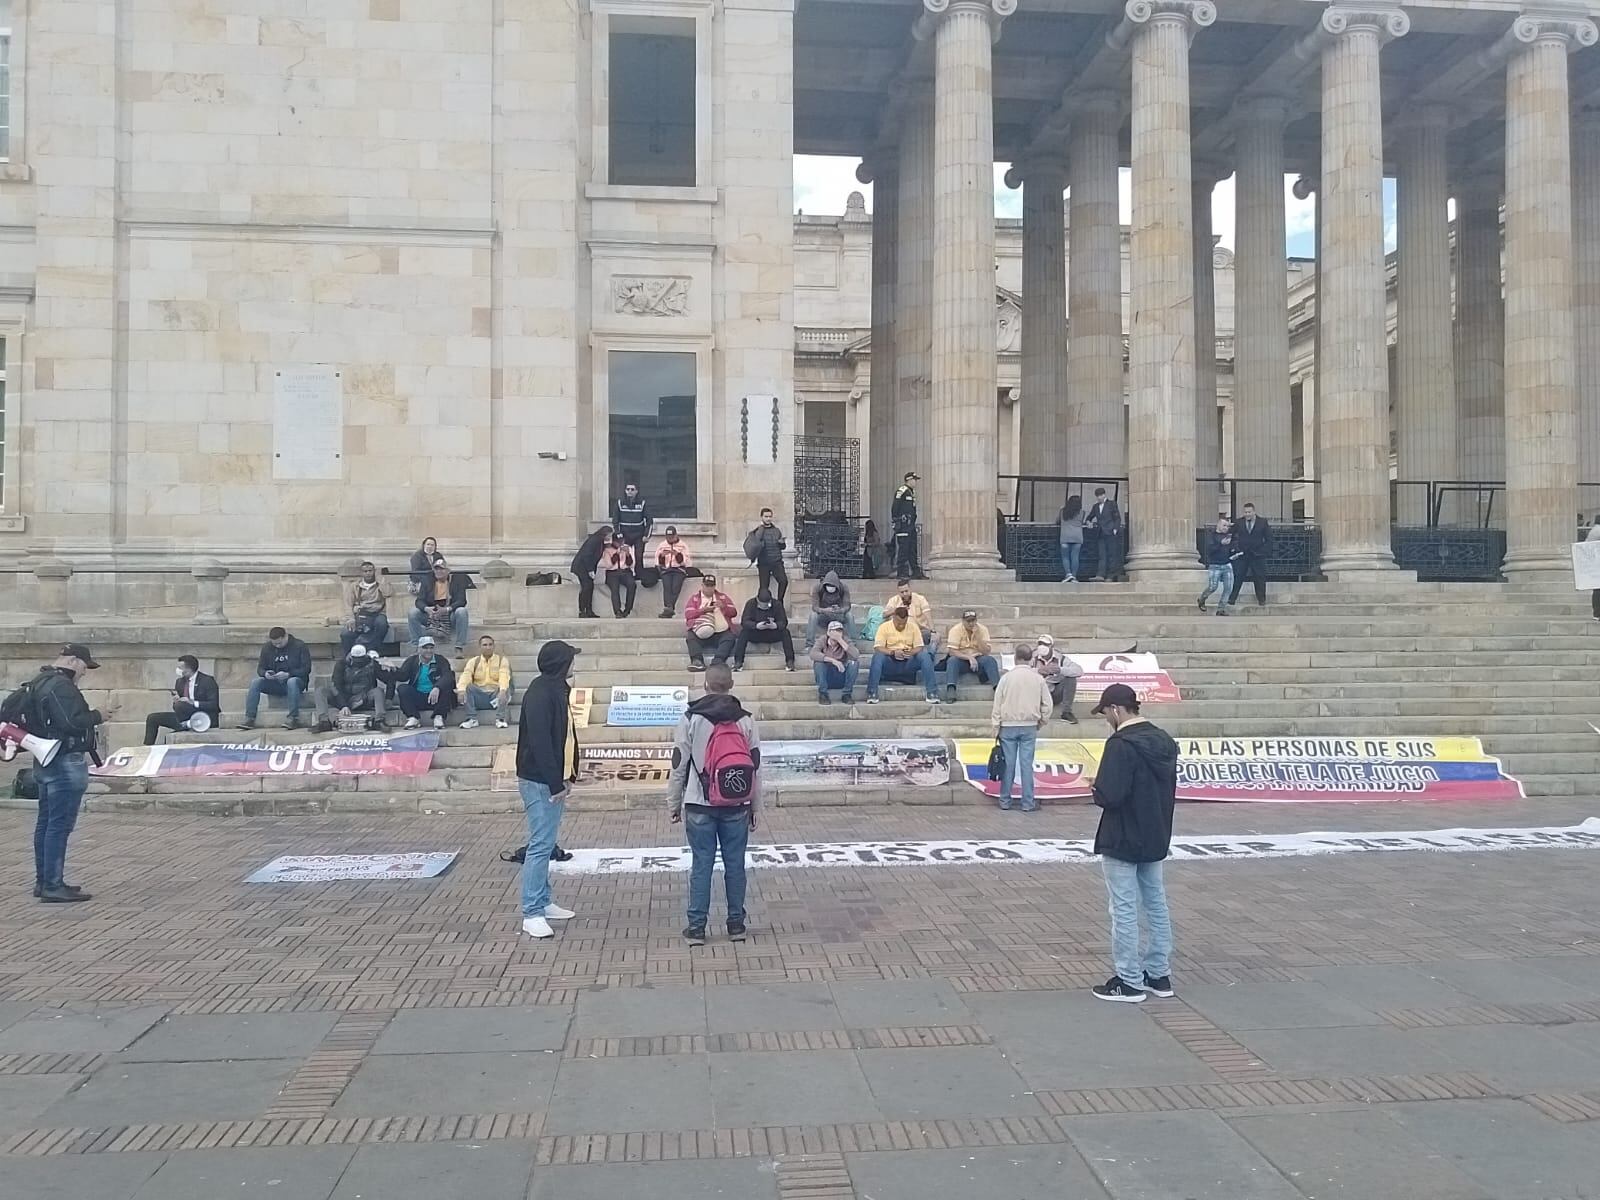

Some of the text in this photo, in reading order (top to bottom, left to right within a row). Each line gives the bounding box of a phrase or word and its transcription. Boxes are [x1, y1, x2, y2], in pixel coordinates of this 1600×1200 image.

[373, 738, 389, 748] DE
[1189, 740, 1437, 758] A LAS PERSONAS DE SUS
[268, 749, 338, 771] UTC
[585, 749, 641, 759] HUMANOS
[646, 750, 653, 758] Y
[1249, 764, 1275, 782] EN
[1280, 765, 1331, 783] TELA
[1336, 767, 1364, 783] DE
[598, 847, 1023, 870] FRNCISCO
